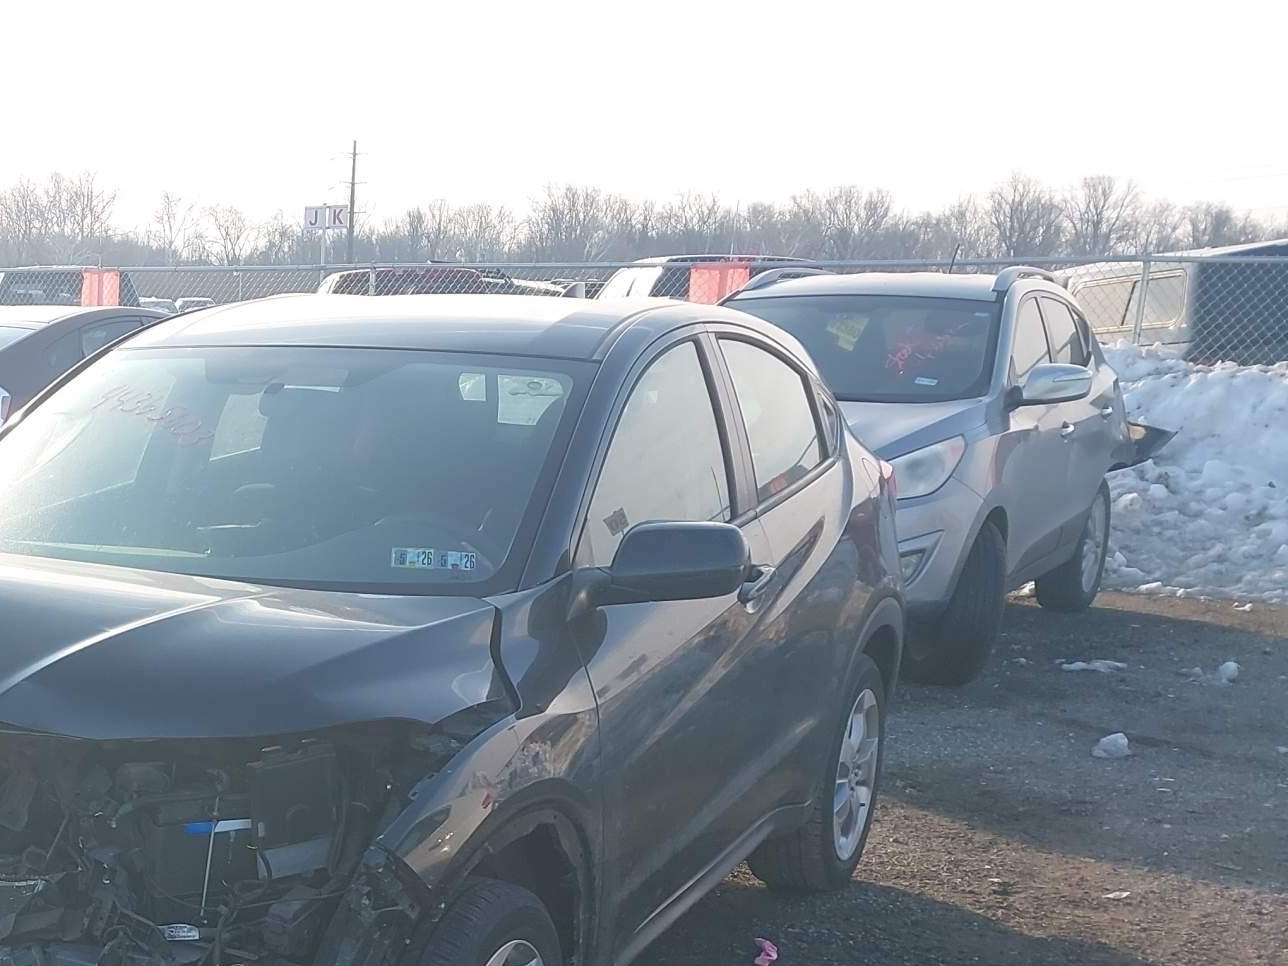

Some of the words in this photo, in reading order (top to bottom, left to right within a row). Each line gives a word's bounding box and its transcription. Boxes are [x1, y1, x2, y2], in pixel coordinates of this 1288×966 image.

[309, 210, 318, 226] J
[332, 209, 344, 225] K
[464, 553, 475, 569] 26
